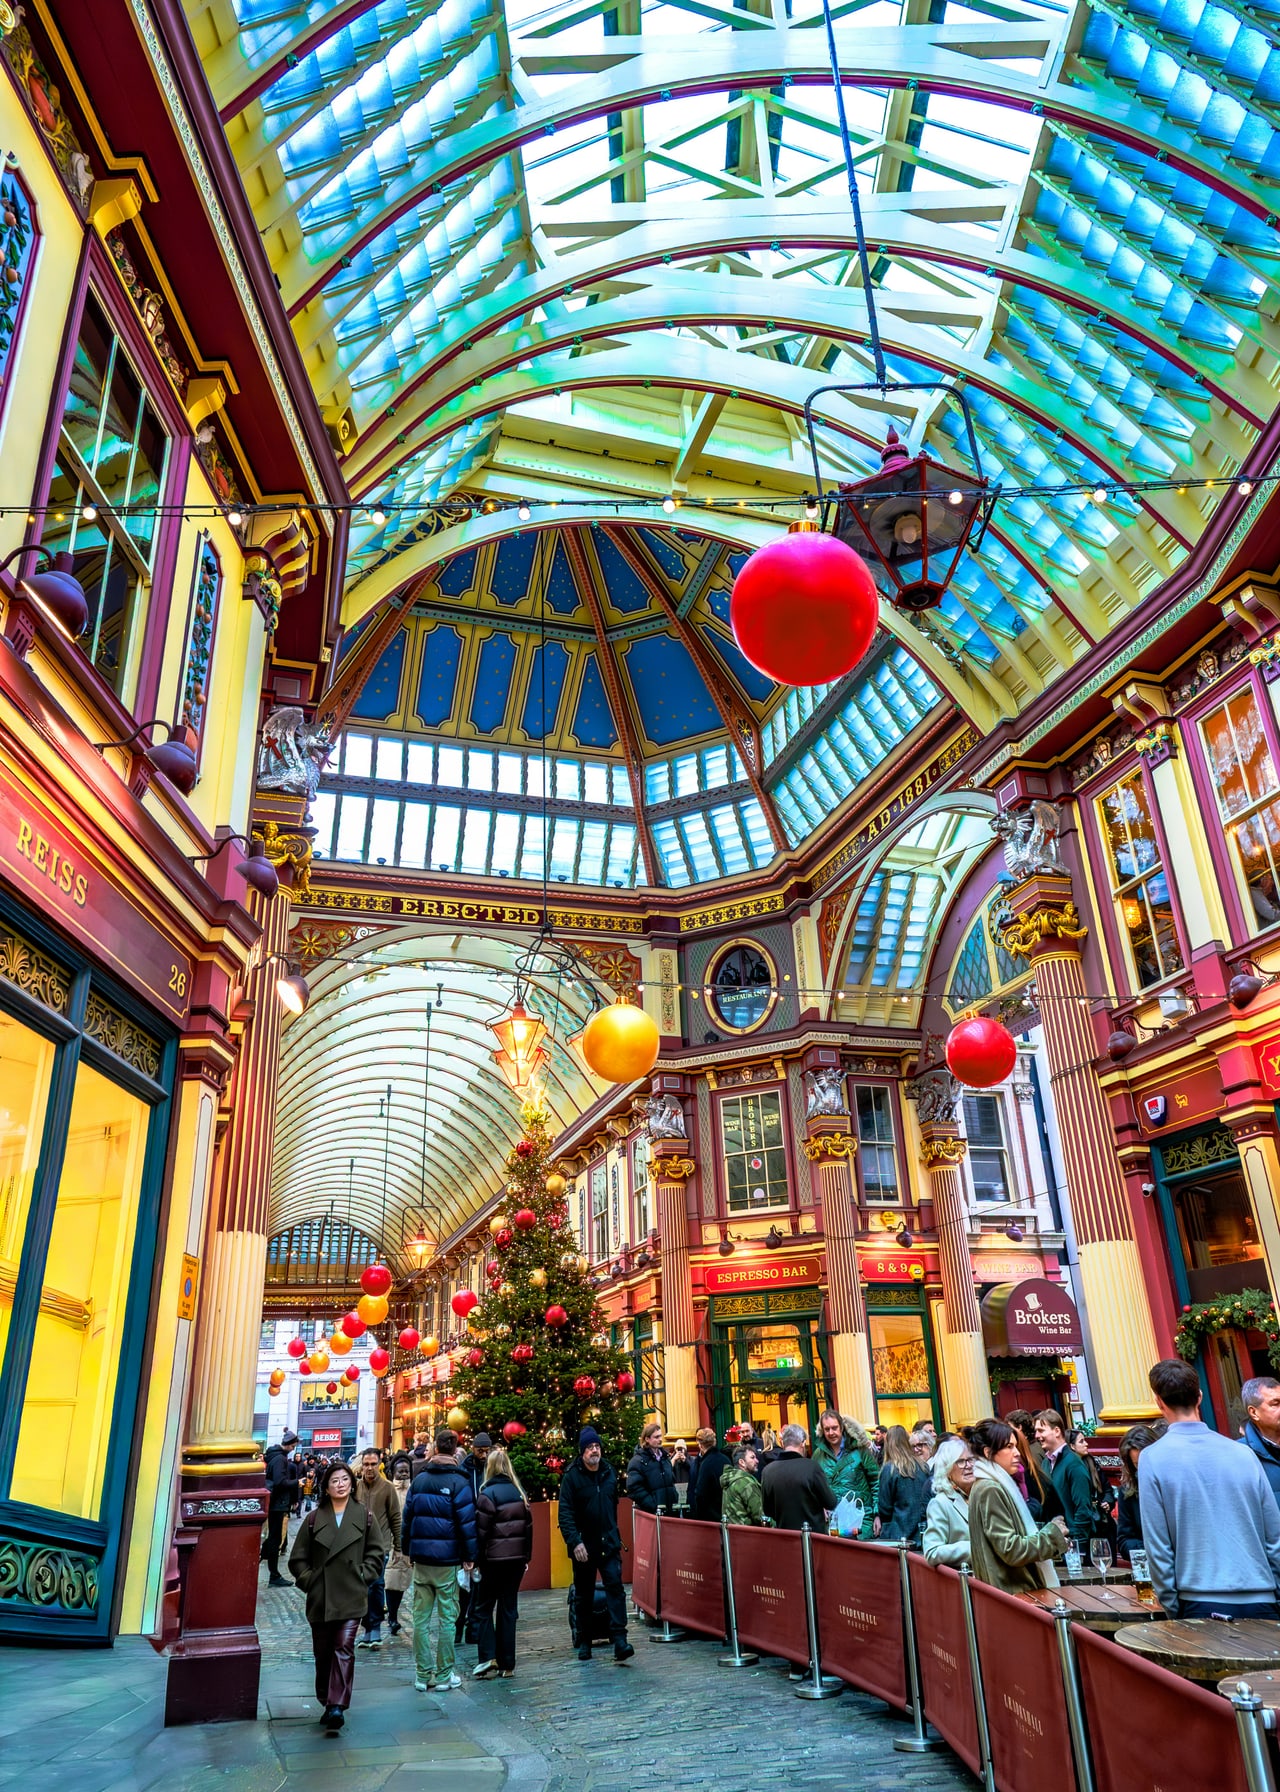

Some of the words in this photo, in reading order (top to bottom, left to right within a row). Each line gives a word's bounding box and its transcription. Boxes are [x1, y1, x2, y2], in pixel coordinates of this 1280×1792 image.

[898, 768, 933, 813] 1881
[16, 818, 88, 907] REISS
[400, 898, 540, 925] ERECTED
[168, 964, 187, 998] 26
[722, 989, 767, 1003] RESTAURANT
[747, 1099, 758, 1147] BROKERS
[763, 1113, 779, 1121] WINE
[717, 1268, 779, 1284] ESPRESSO
[782, 1265, 808, 1278] BAR
[877, 1262, 885, 1273] 8
[888, 1262, 897, 1273] &
[900, 1262, 908, 1273] 9
[981, 1263, 1012, 1274] WINE
[1014, 1263, 1038, 1273] BAR
[1014, 1309, 1071, 1325] Brokers
[1038, 1326, 1058, 1334] Wine
[1059, 1326, 1072, 1334] Bar
[676, 1568, 704, 1582] LEADENHALL
[752, 1584, 786, 1599] LEADENHALL
[839, 1604, 878, 1626] LEADENHALL
[847, 1619, 869, 1631] MARKET
[1003, 1693, 1044, 1737] LEADENHALL
